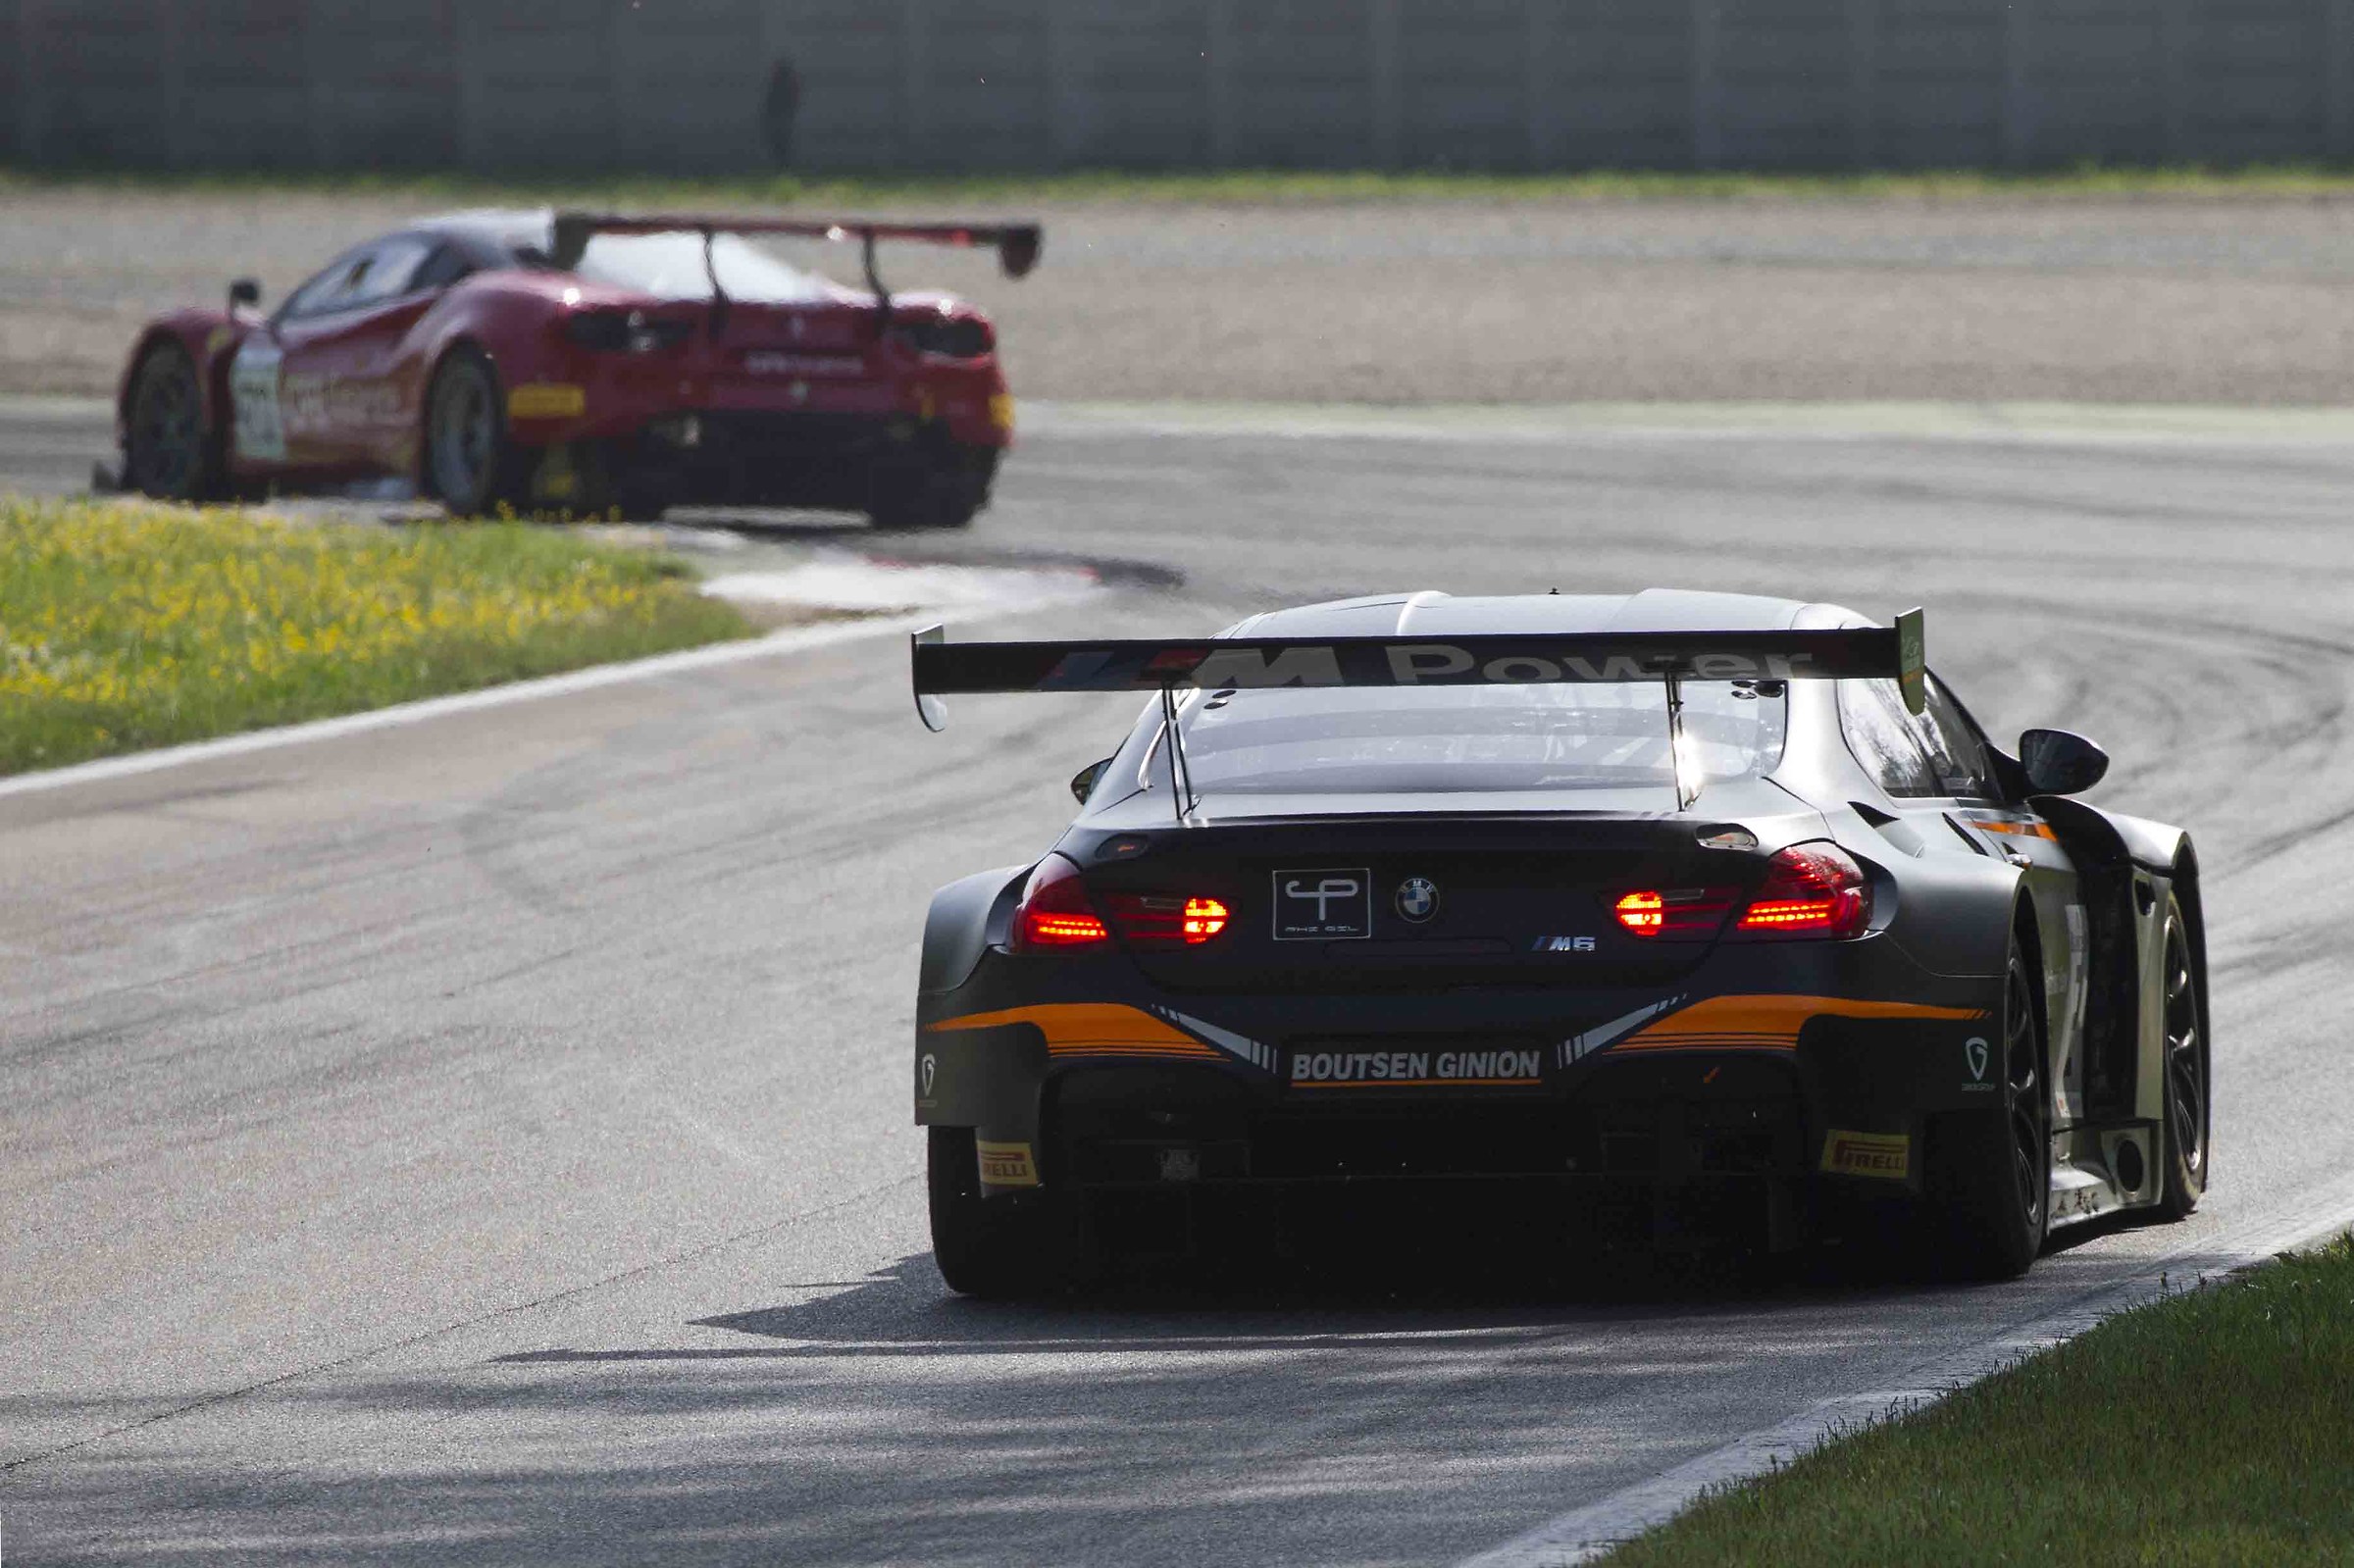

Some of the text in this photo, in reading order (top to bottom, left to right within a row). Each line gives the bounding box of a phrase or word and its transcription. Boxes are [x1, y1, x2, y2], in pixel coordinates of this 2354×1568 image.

[1189, 642, 1815, 688] M Power
[1291, 1050, 1541, 1081] BOUTSEN GINION
